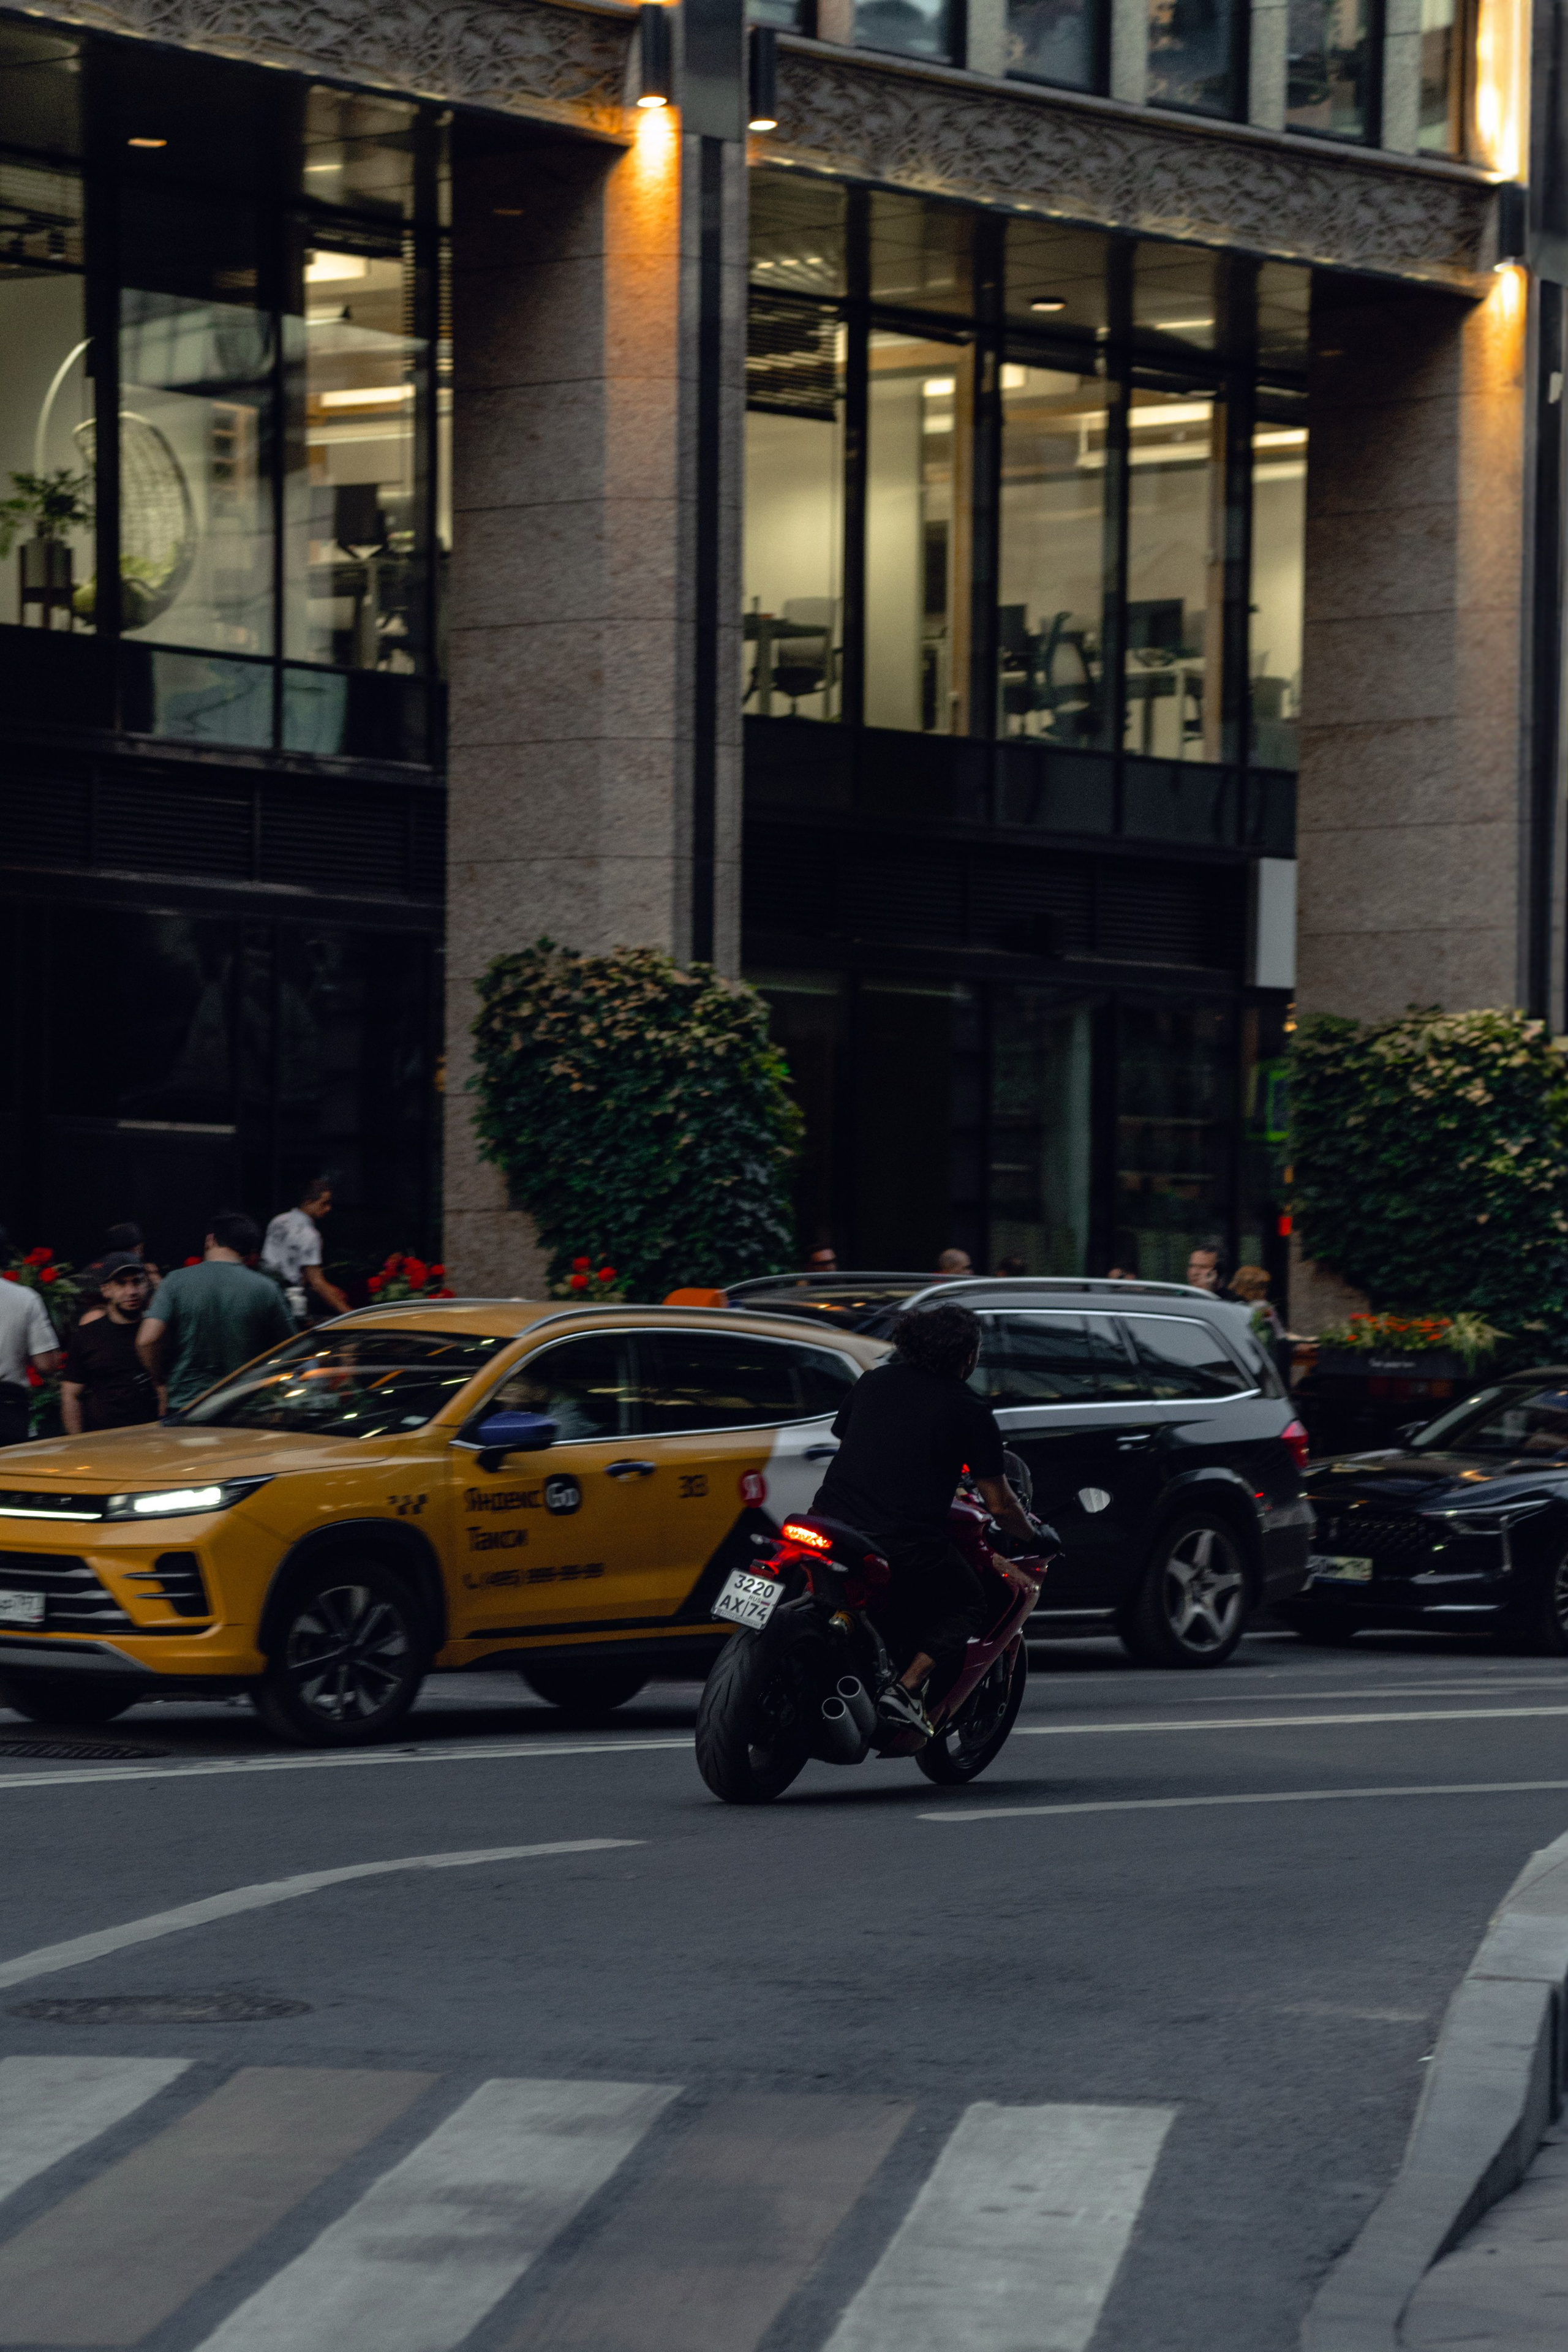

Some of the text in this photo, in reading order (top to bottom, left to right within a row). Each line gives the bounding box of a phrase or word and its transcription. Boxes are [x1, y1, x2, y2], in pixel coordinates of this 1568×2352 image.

[464, 1482, 579, 1514] Яндекс Go
[466, 1526, 529, 1551] Такси
[734, 1575, 774, 1597] 3220
[748, 1595, 761, 1604] RUS
[747, 1603, 768, 1621] 74
